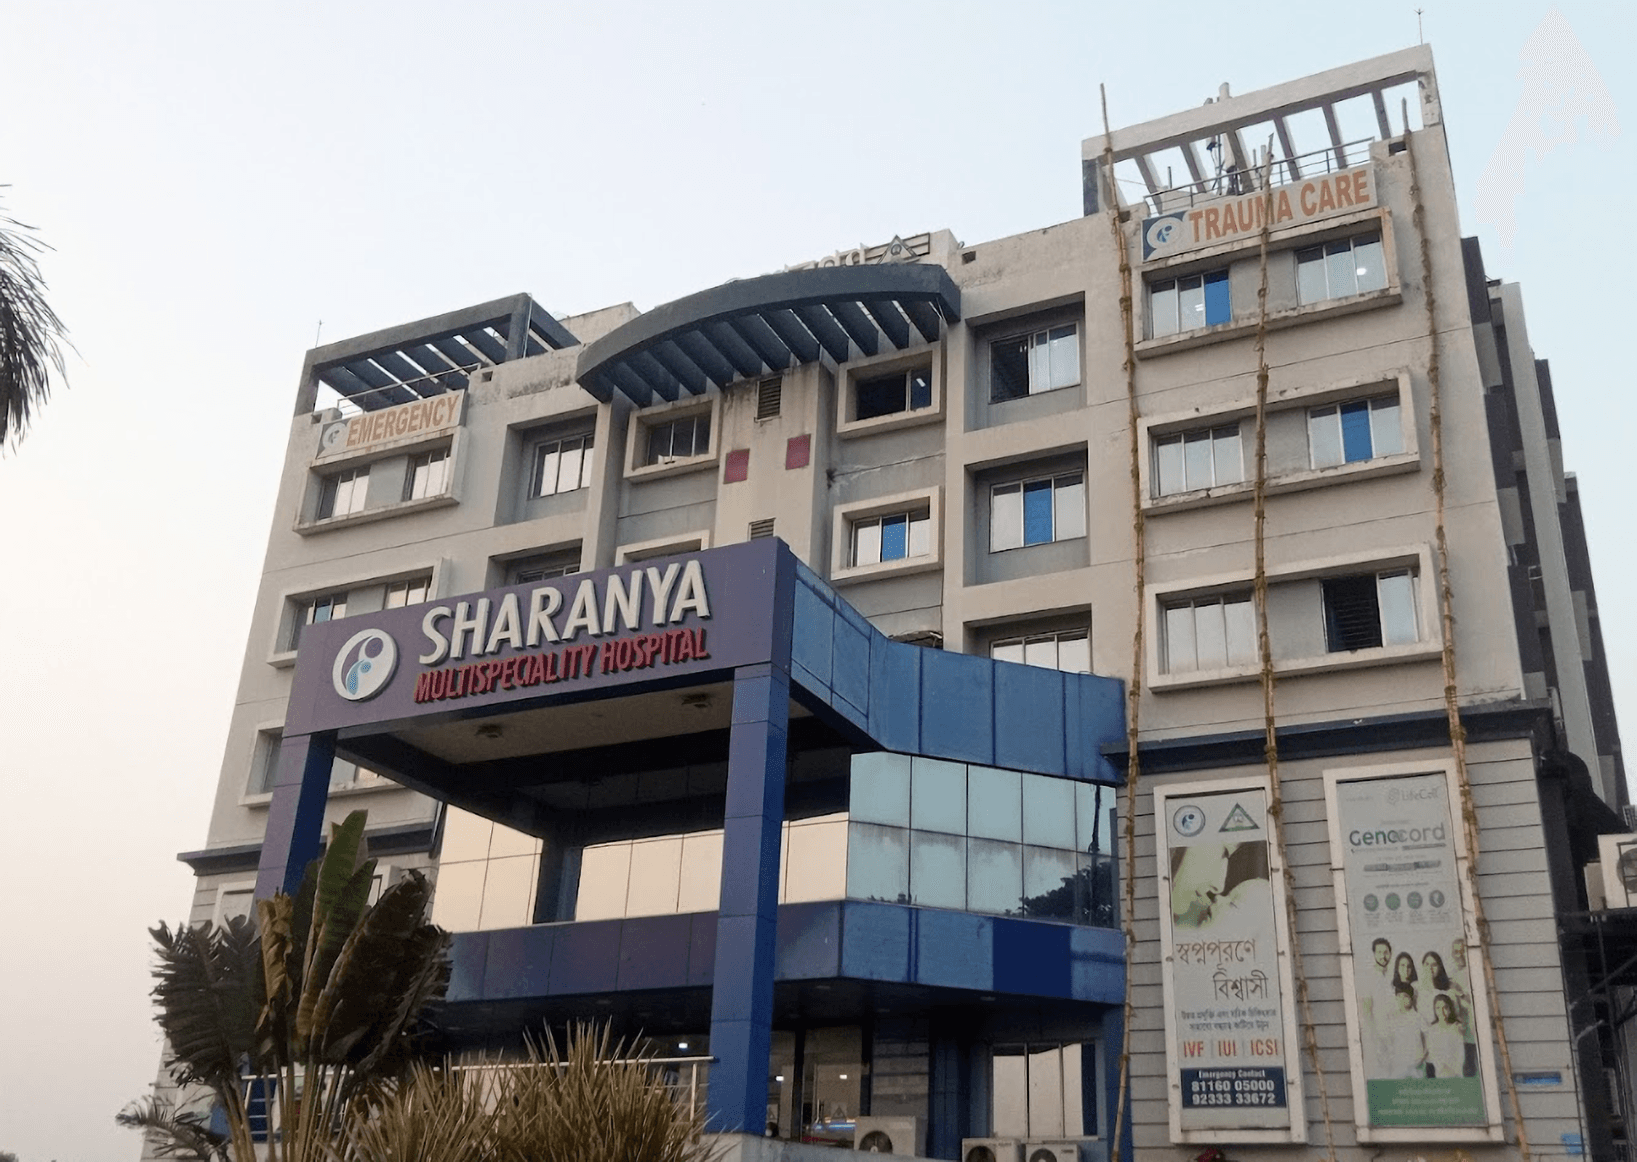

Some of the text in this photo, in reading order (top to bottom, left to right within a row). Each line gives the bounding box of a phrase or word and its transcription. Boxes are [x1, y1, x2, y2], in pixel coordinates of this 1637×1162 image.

[1188, 170, 1370, 243] TRAUMA CARE
[346, 394, 460, 447] EMERGENCY
[418, 559, 711, 666] SHARANYA
[413, 627, 710, 703] MULTISPECIALITY HOSPITAL
[1183, 1038, 1278, 1057] IVF IUI ICSI
[1191, 1079, 1275, 1092] 81160 05000
[1192, 1093, 1231, 1105] 92333
